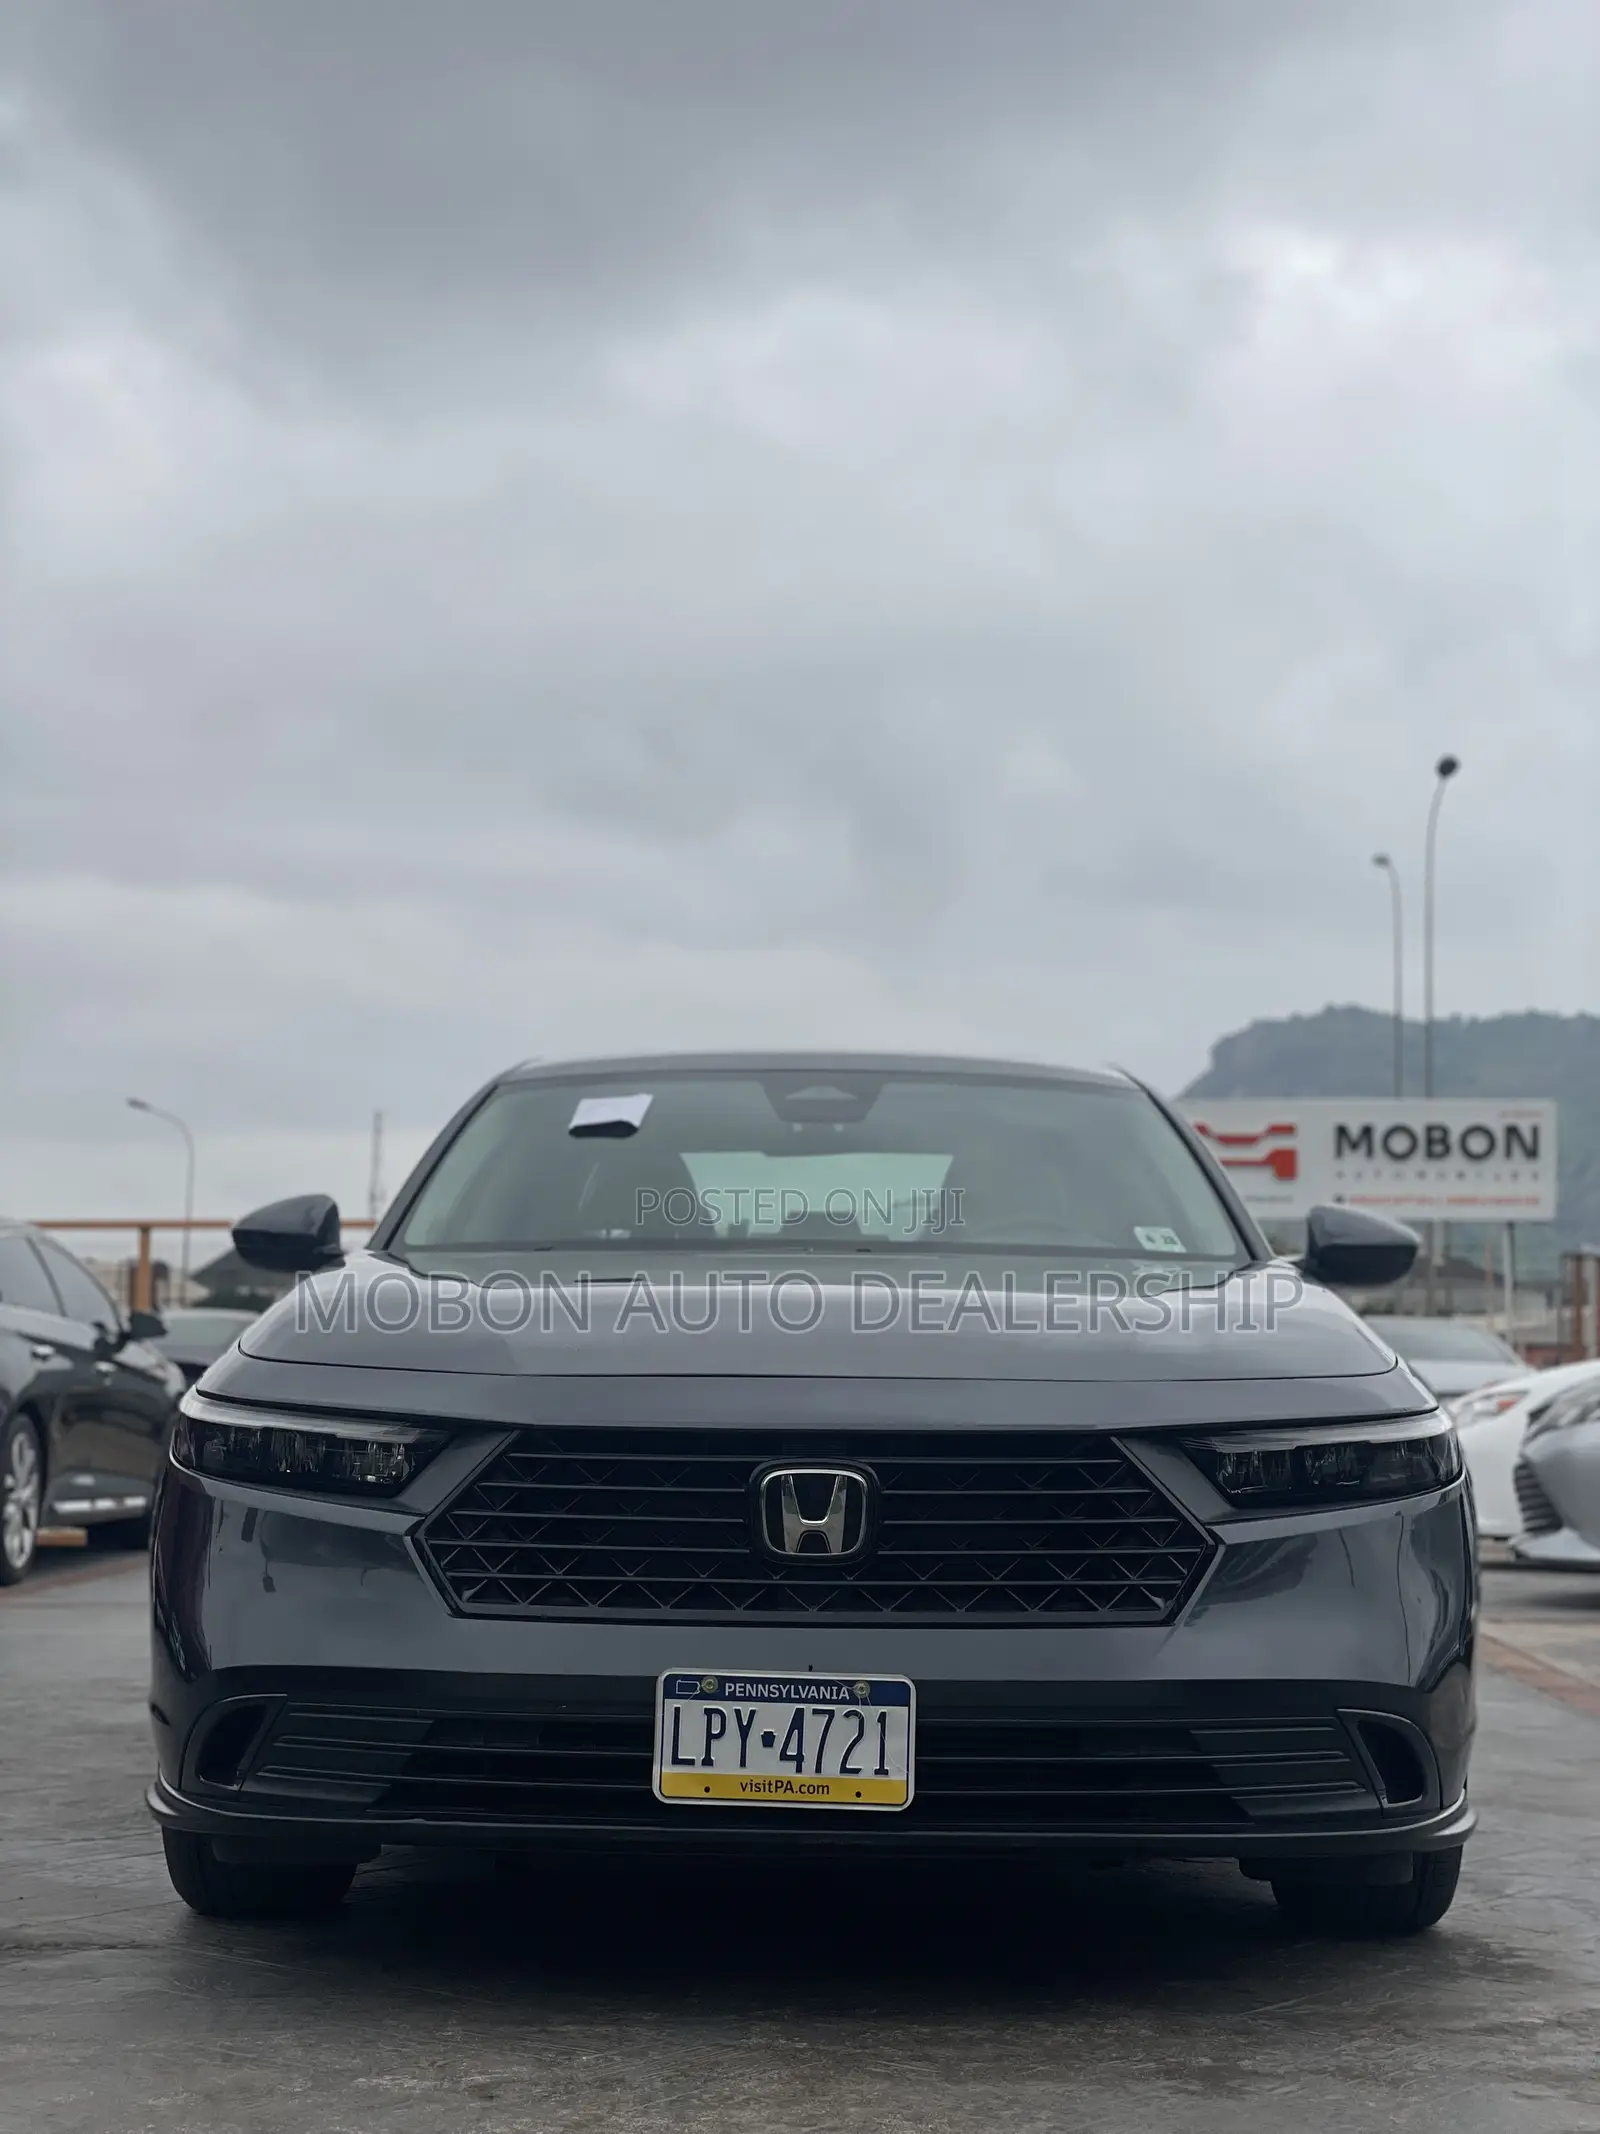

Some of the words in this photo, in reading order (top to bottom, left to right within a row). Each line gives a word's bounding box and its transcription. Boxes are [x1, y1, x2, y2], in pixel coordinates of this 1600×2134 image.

[1335, 1123, 1540, 1161] MOBON
[725, 1683, 850, 1700] PENNSYLVANIA
[740, 1779, 830, 1795] visitPA.com
